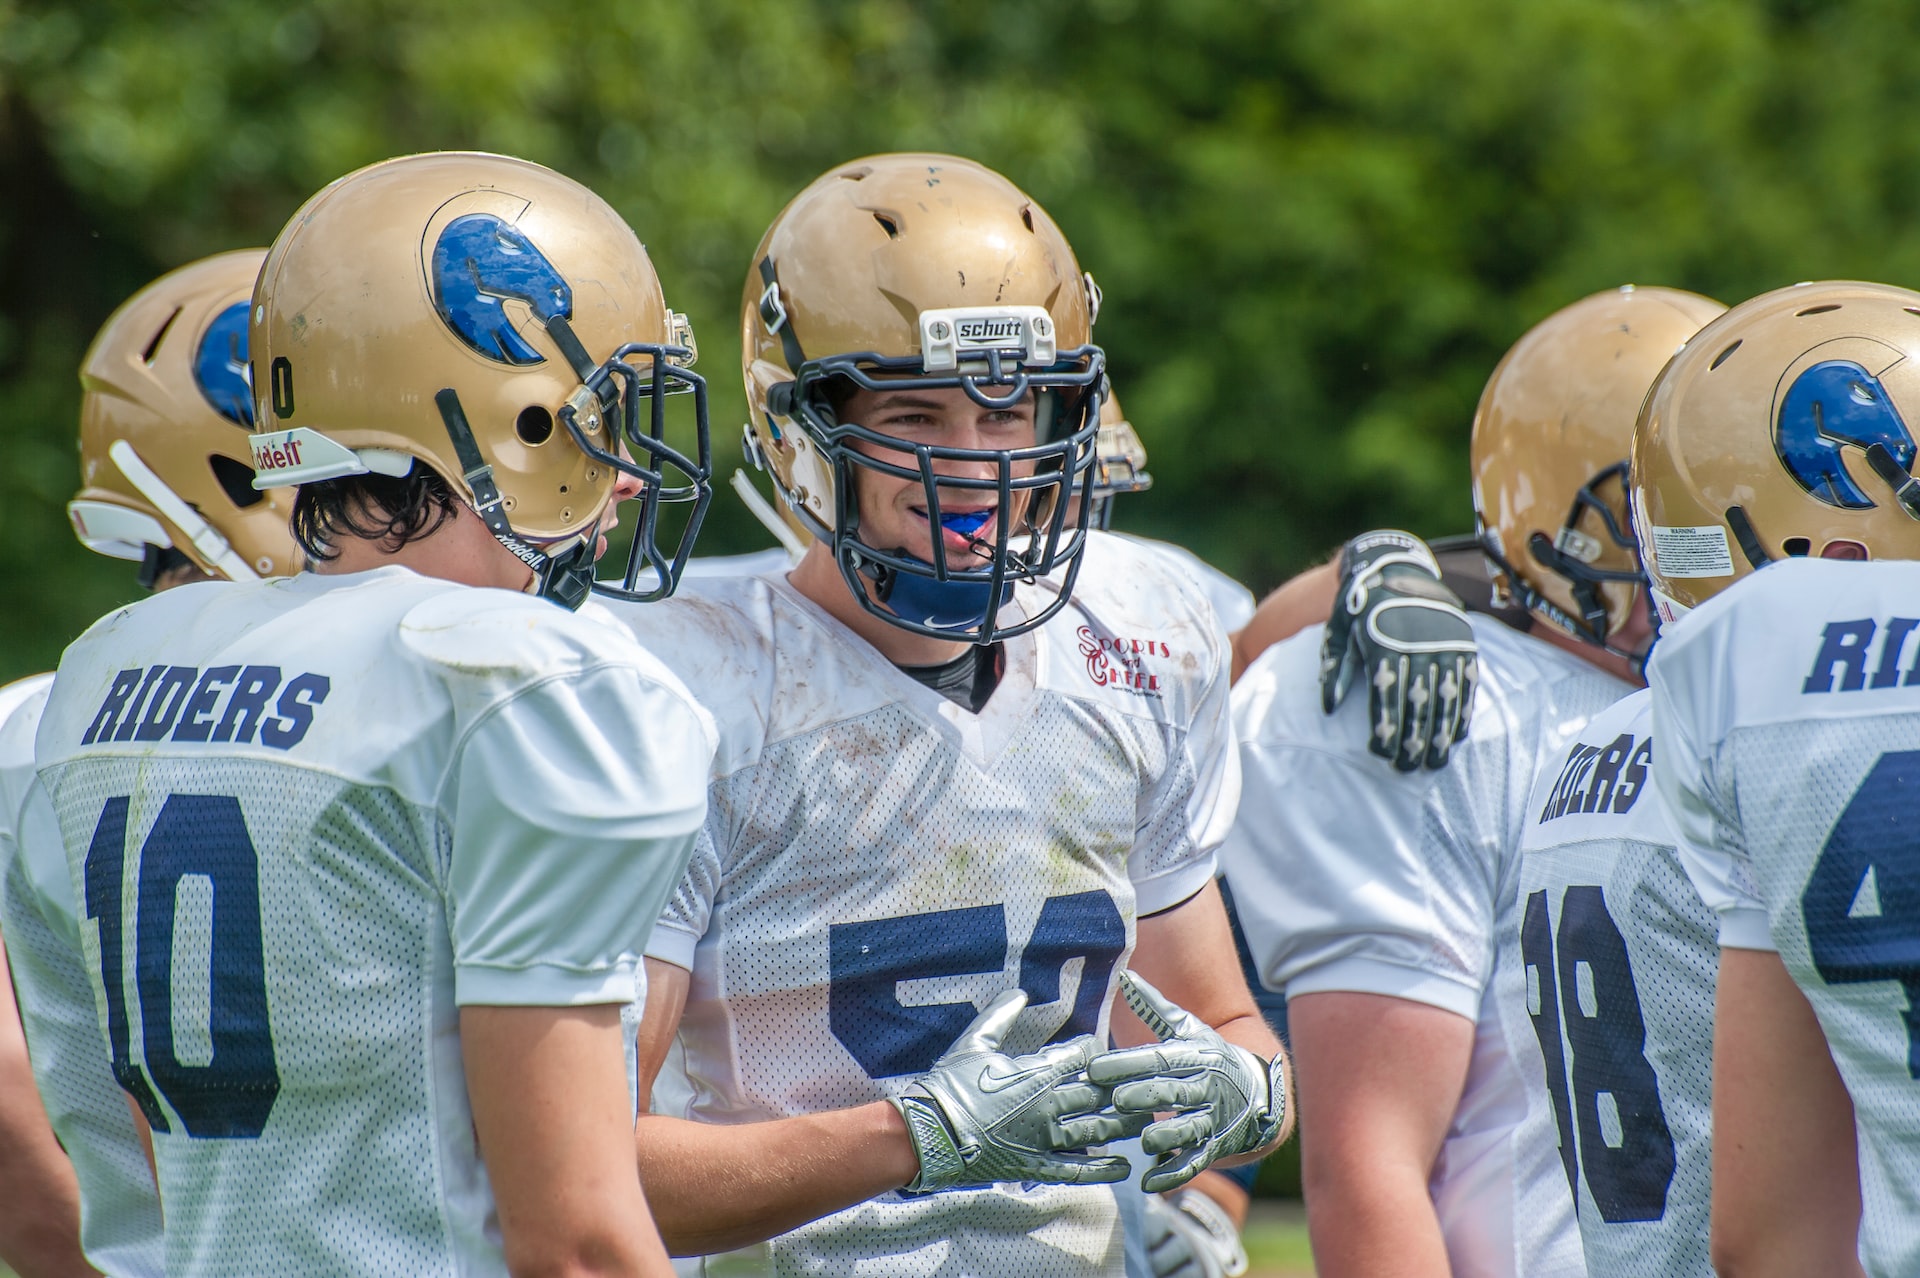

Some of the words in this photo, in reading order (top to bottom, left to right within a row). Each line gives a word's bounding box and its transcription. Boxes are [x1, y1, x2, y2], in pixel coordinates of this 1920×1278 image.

[960, 320, 1021, 336] schutt
[1077, 625, 1170, 658] SPORTS
[81, 665, 330, 751] RIDERS
[85, 793, 281, 1139] 10
